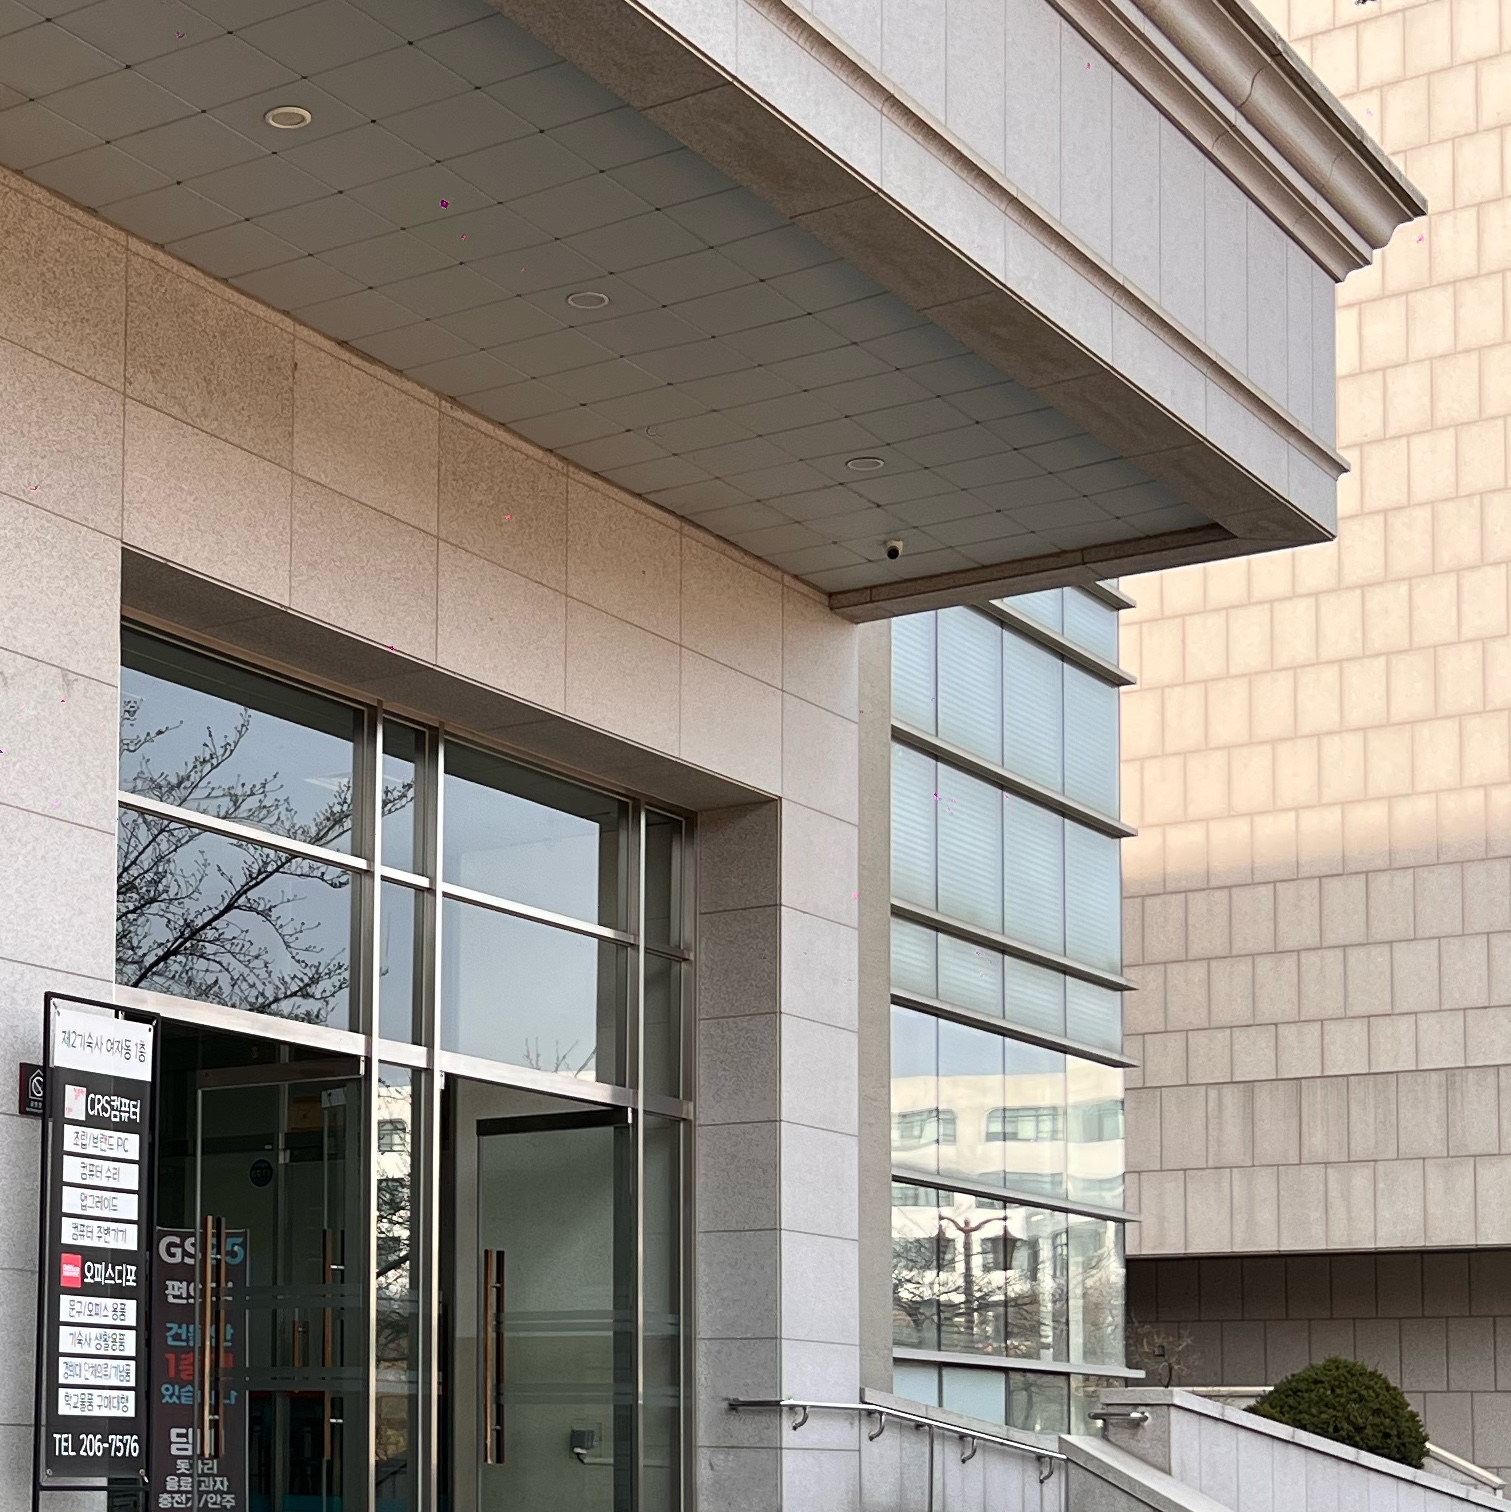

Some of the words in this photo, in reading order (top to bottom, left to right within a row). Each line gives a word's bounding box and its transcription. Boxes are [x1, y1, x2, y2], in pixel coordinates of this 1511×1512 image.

[61, 1029, 104, 1055] 제2기숙사
[106, 1037, 132, 1061] 여자동
[134, 1039, 147, 1063] 1층
[88, 1093, 141, 1123] CRS컴퓨터
[73, 1130, 115, 1153] 조립/브랜드
[116, 1136, 129, 1153] PC
[80, 1161, 104, 1181] 컴퓨터
[105, 1165, 121, 1182] 수리
[80, 1192, 119, 1212] 업그레이드
[71, 1222, 94, 1241] 컴퓨터
[96, 1225, 127, 1244] 주변기기
[158, 1235, 245, 1265] GS5
[83, 1261, 137, 1287] 오피스디포
[69, 1299, 110, 1318] 문구/오피스
[111, 1302, 127, 1321] 용품
[68, 1330, 92, 1350] 기숙사
[94, 1331, 126, 1352] 생활용품
[96, 1393, 129, 1413] 구매대행
[53, 1433, 76, 1456] TEL
[79, 1433, 139, 1457] 206-7576
[165, 1475, 229, 1491] 음료과자
